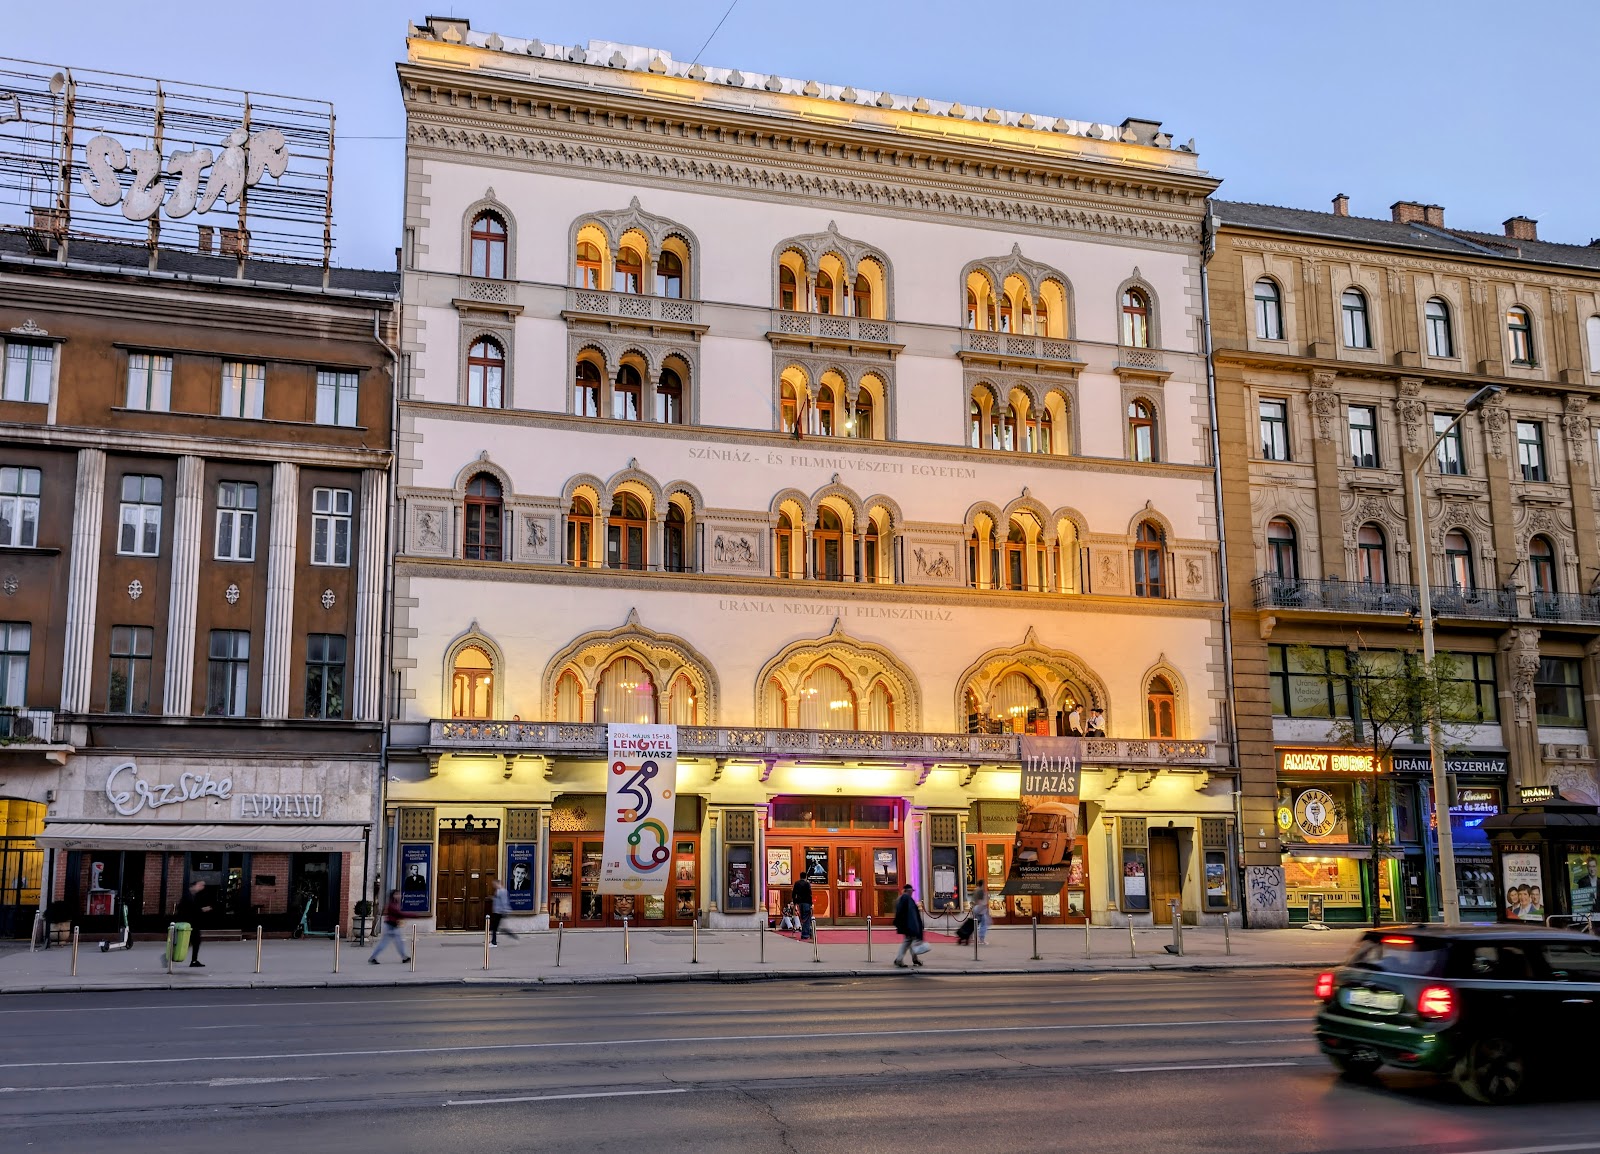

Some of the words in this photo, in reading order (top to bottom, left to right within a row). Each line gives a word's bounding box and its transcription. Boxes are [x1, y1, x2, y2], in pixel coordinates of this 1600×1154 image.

[767, 451, 783, 465] ÉS
[790, 455, 904, 475] FILMMŰVÉSZETI
[911, 464, 976, 479] EGYETEM
[719, 599, 775, 613] URÁNIA
[783, 603, 849, 617] NEMZETI
[856, 606, 953, 622] FILMSZÍNHÁZ
[1295, 687, 1320, 695] Medical
[613, 738, 672, 751] LENGYEL
[613, 750, 672, 759] FILMTAVASZ
[1027, 751, 1076, 773] ITÁLIAI
[1284, 753, 1328, 771] AMAZY
[1025, 773, 1075, 793] UTAZÁS
[241, 794, 323, 818] ESPRESSO
[1301, 792, 1329, 804] AMAZY
[1301, 820, 1333, 834] BURGER
[1508, 865, 1538, 873] SZAVAZZ
